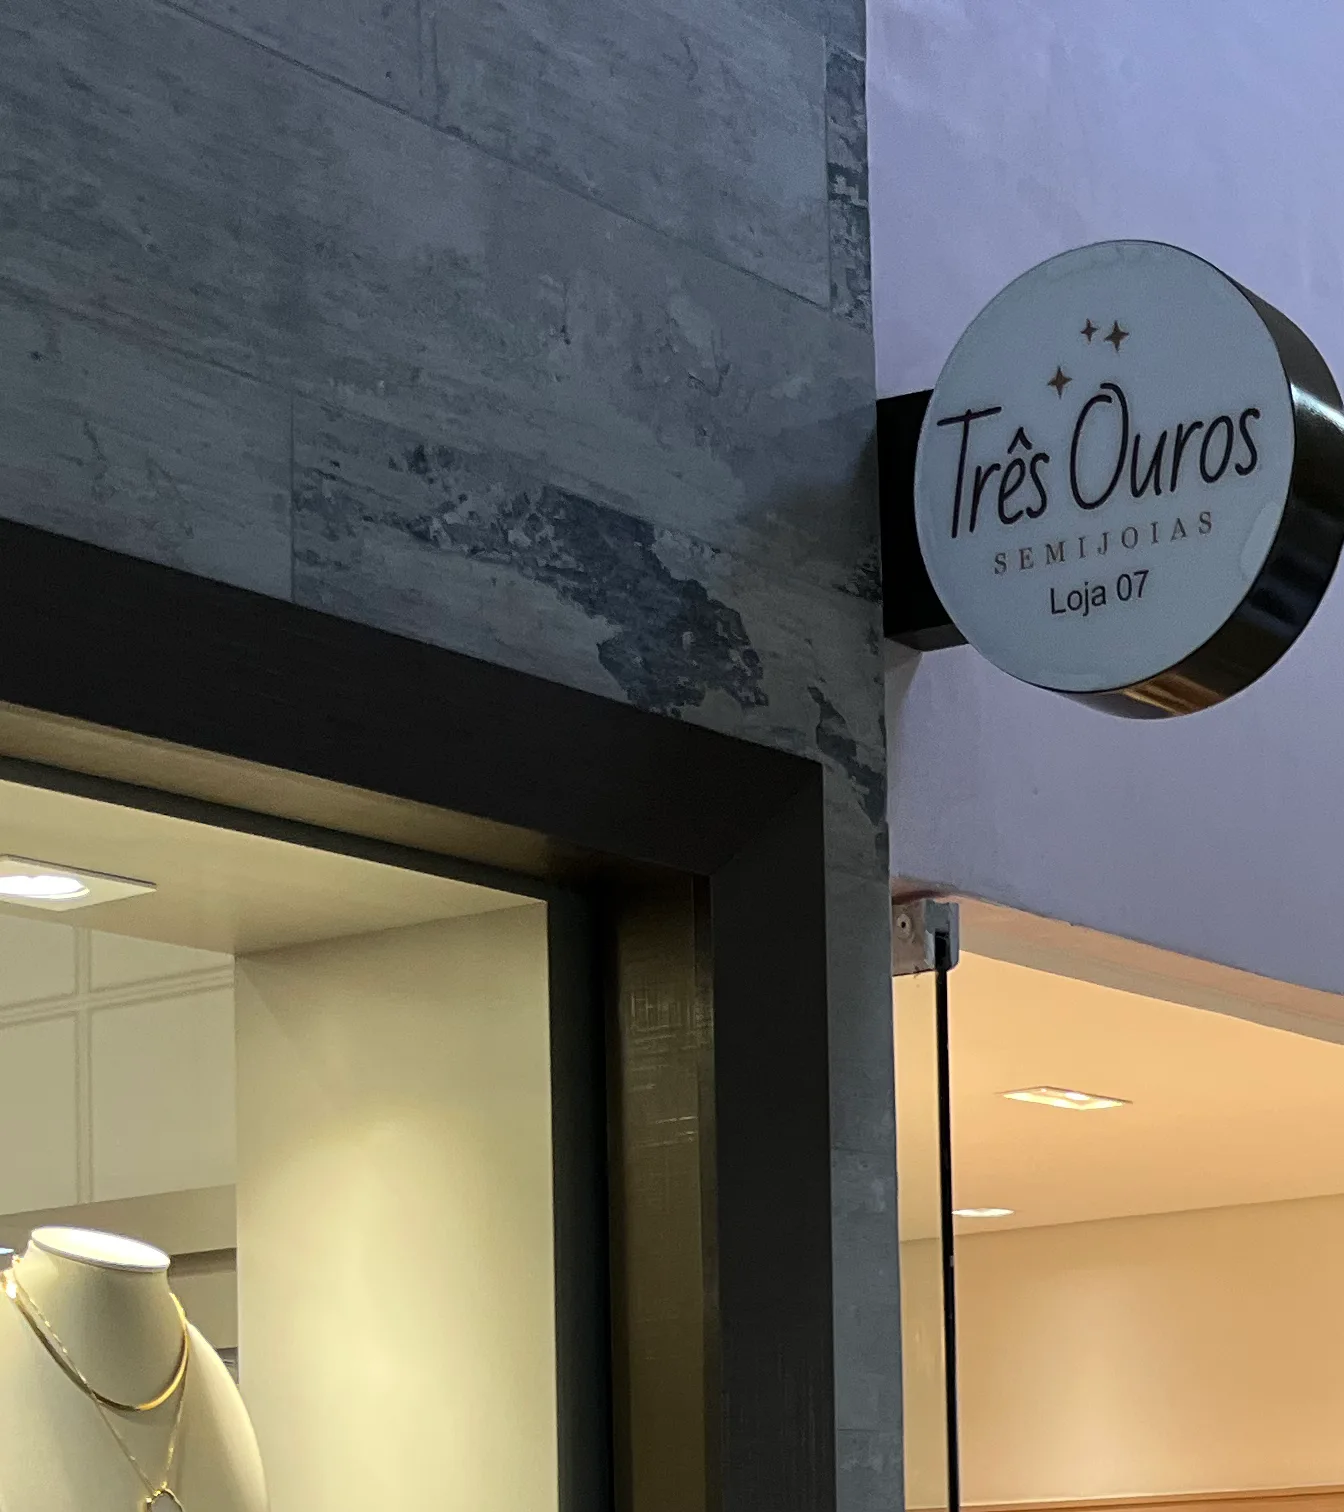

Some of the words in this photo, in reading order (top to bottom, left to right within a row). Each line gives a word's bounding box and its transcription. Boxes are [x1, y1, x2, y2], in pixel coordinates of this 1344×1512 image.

[937, 406, 1051, 539] Três
[1069, 382, 1261, 511] Ouros
[993, 510, 1214, 576] SEMIJOIAS
[1049, 581, 1107, 618] Loja
[1116, 569, 1150, 603] 07
